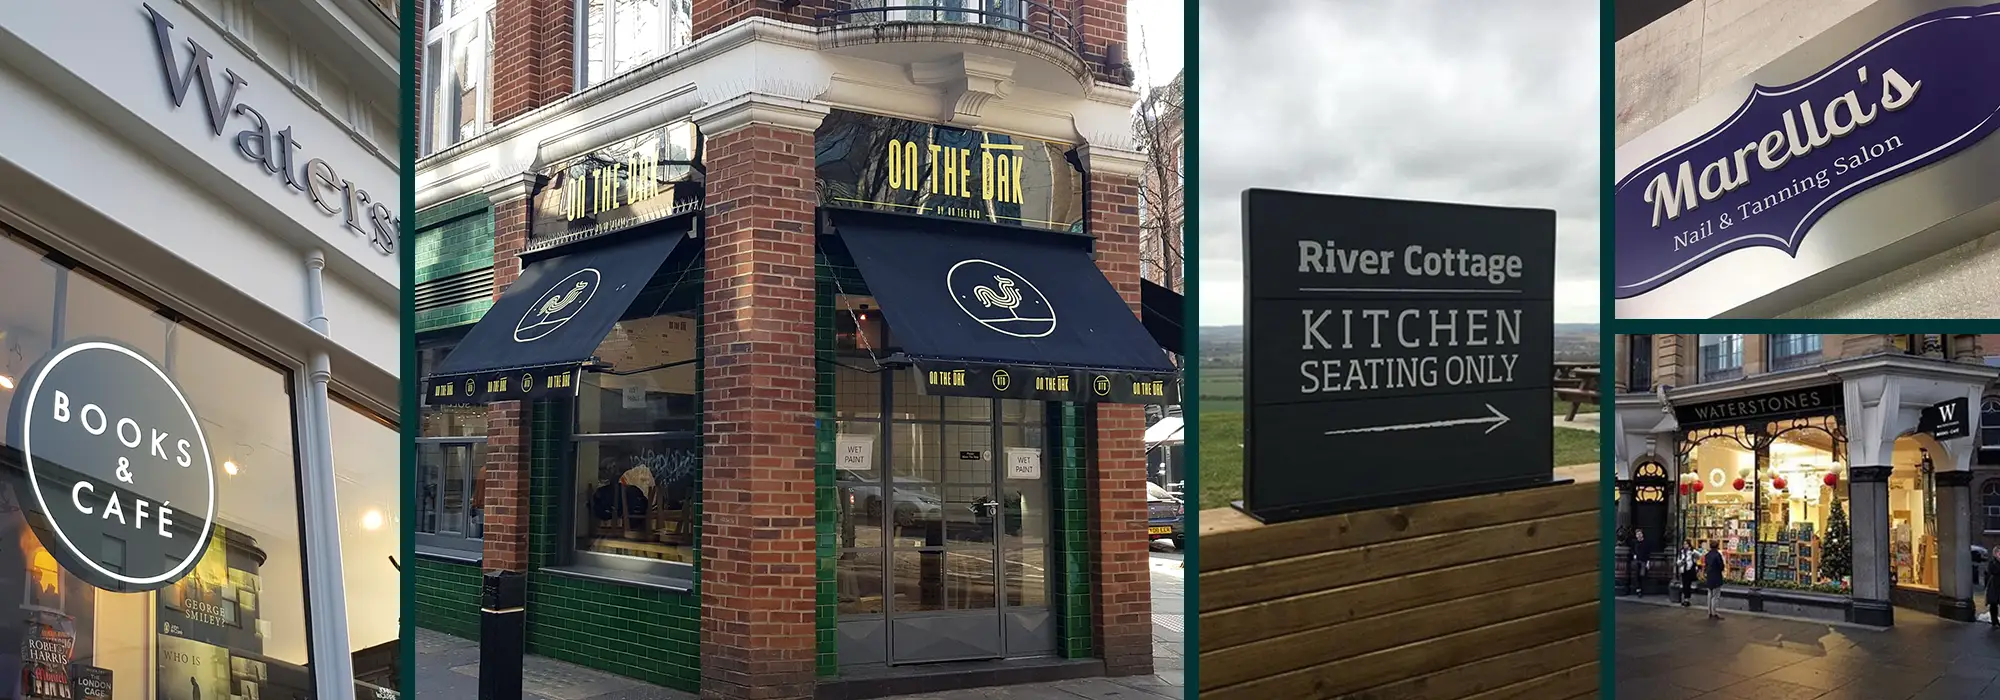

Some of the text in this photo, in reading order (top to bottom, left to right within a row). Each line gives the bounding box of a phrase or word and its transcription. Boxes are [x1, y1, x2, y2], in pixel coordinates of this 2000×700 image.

[142, 2, 400, 255] Waters
[1643, 65, 1922, 228] Marella's
[888, 139, 918, 191] ON
[928, 144, 971, 198] THE
[567, 175, 586, 221] ON
[592, 162, 621, 215] THE
[1673, 135, 1904, 252] Nail & Tanning Salon
[1298, 240, 1523, 284] River Cottage
[1301, 308, 1522, 350] KITCHEN
[939, 371, 951, 385] THE
[1300, 354, 1518, 393] SEATING ONLY
[1045, 377, 1056, 391] THE
[1141, 382, 1152, 396] THE
[1694, 391, 1821, 420] WATERSTONES
[1938, 403, 1957, 422] W
[53, 389, 192, 468] BOOKS
[844, 455, 864, 463] PAINT
[1017, 456, 1031, 464] WET
[115, 456, 135, 484] &
[1015, 465, 1033, 473] PAINT
[71, 481, 173, 538] CAFÉ
[185, 598, 226, 617] GEORGE
[185, 609, 226, 628] SMILEY?
[29, 649, 68, 665] HARRIS
[164, 650, 201, 666] WHO IS
[78, 677, 112, 690] LONDON
[84, 687, 106, 698] CAGE
